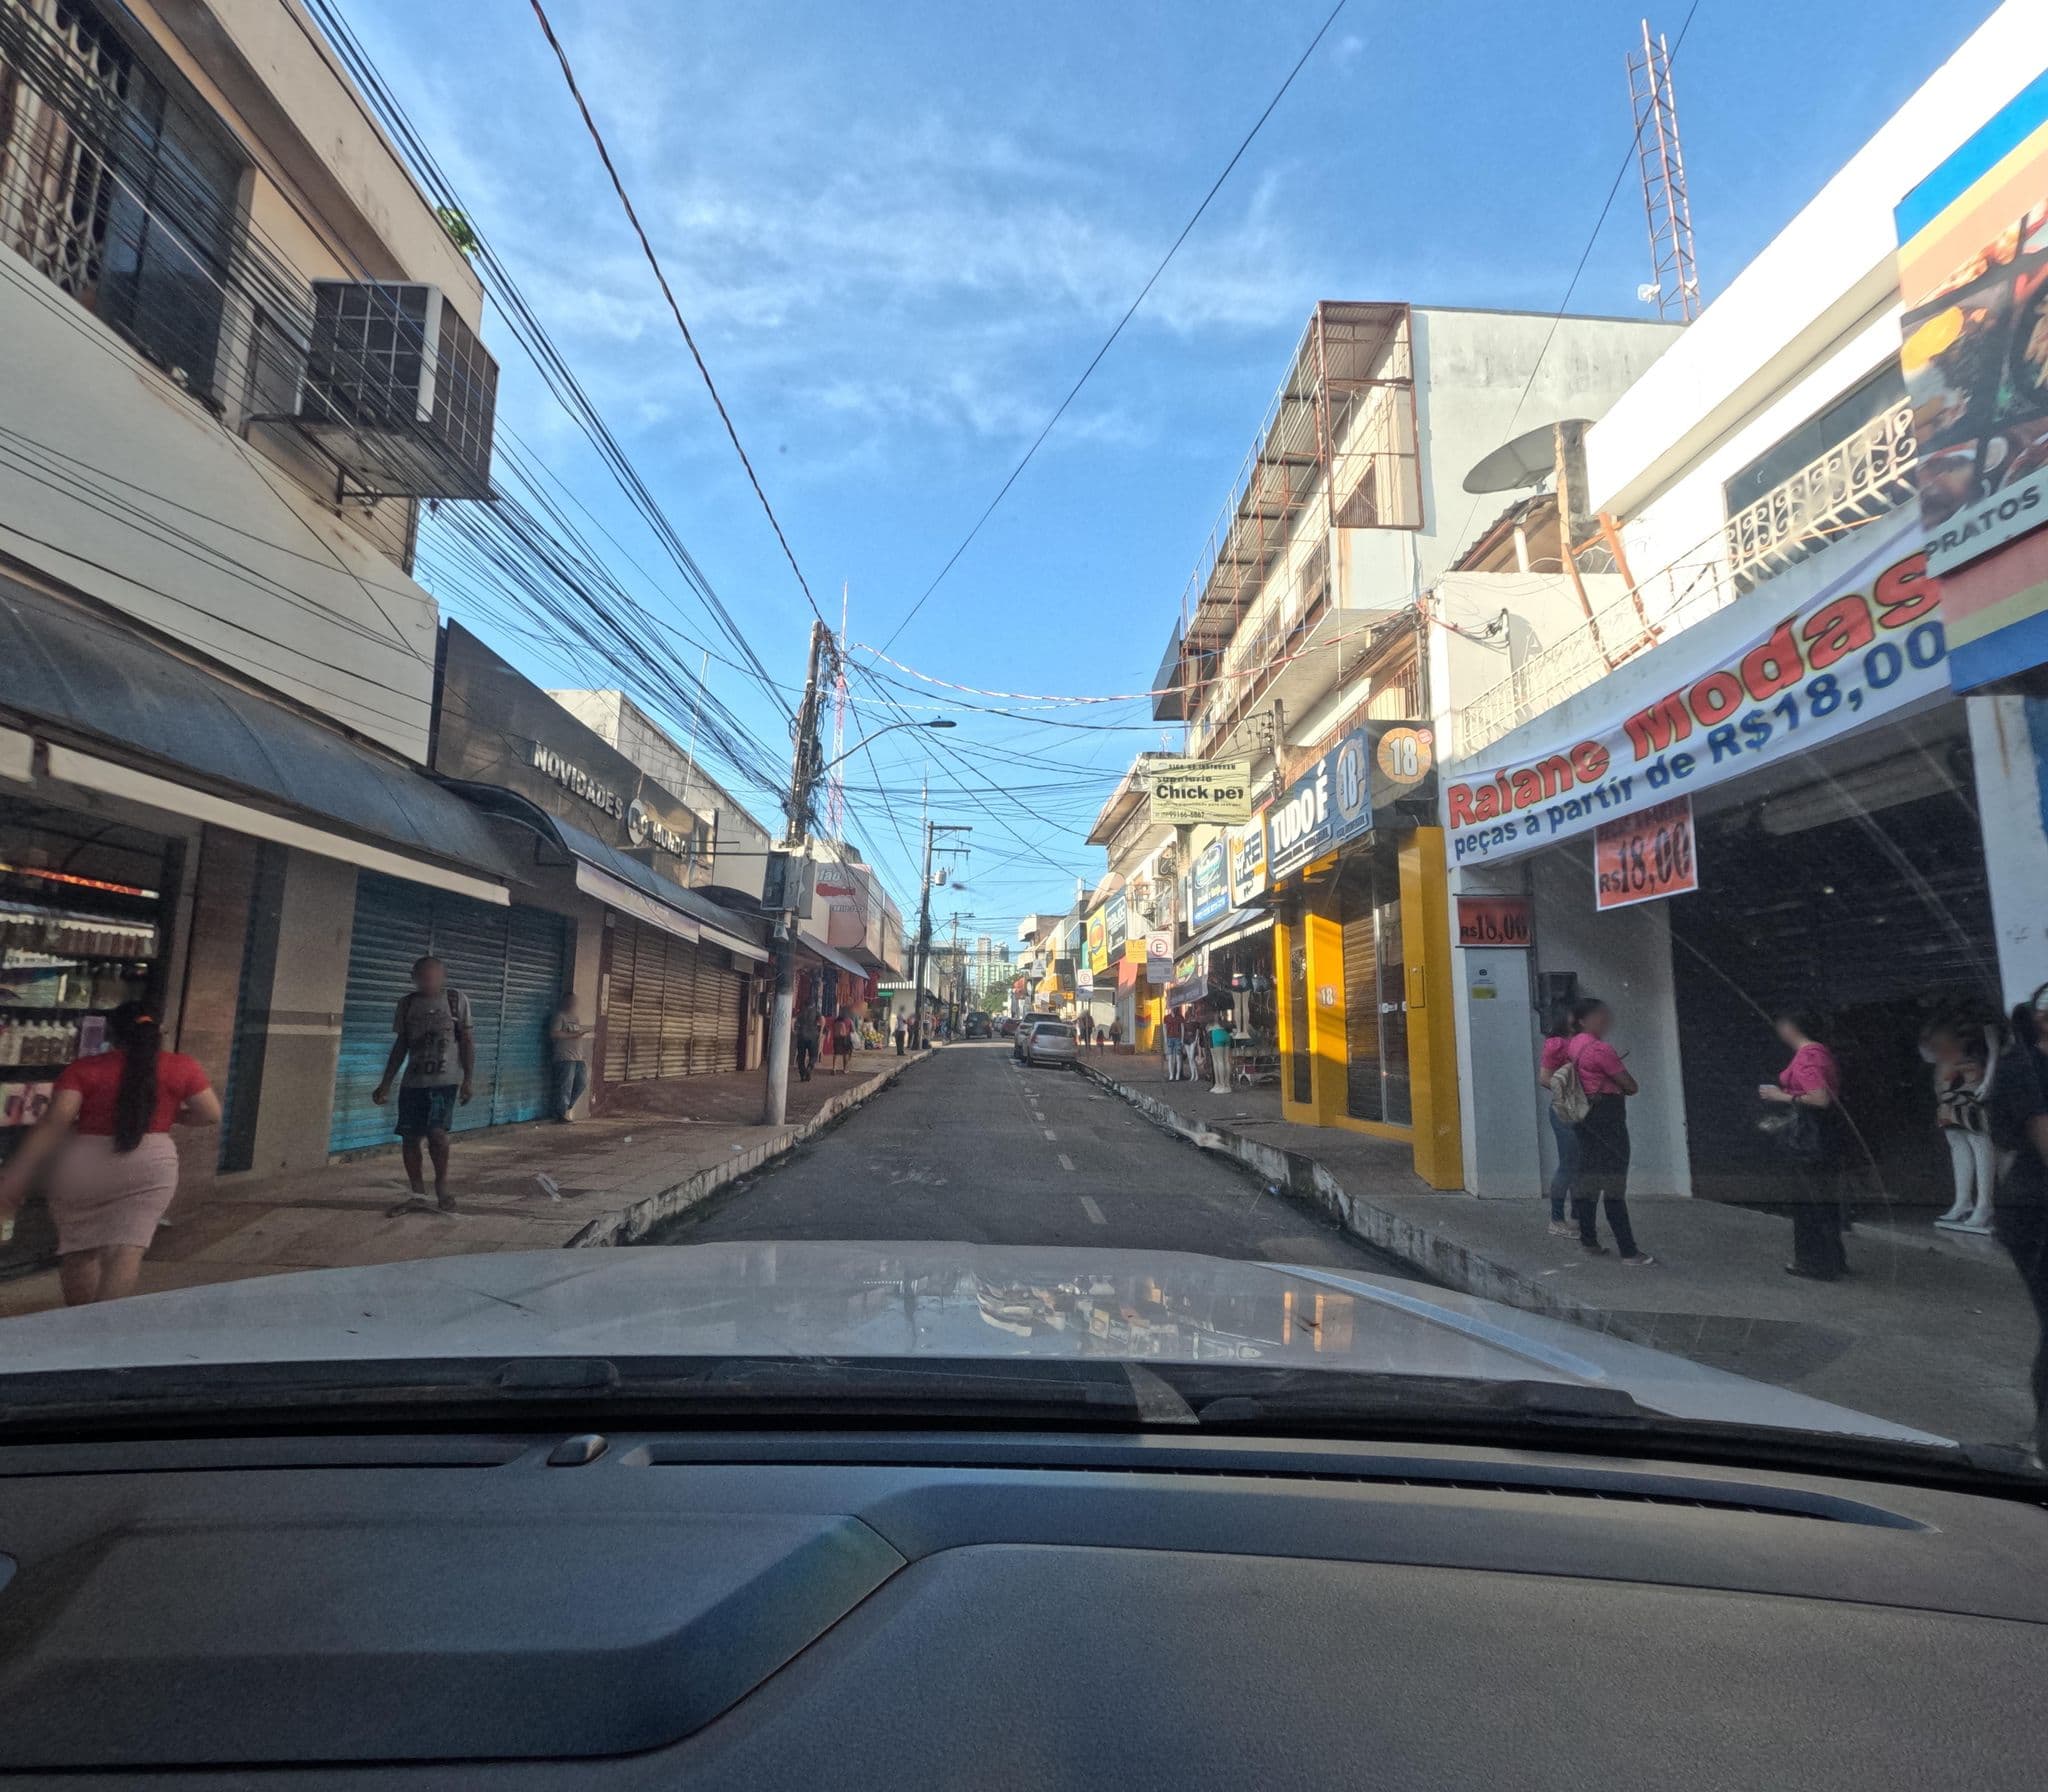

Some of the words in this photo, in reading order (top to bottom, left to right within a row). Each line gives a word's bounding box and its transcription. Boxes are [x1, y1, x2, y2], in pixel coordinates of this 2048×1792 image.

[1923, 485, 2041, 557] PRATOS
[1447, 740, 1610, 829] Raiane
[1623, 550, 1945, 761] Modas
[1389, 736, 1419, 777] 18
[1454, 819, 1518, 860] peças
[1546, 774, 1634, 834] partir
[1645, 751, 1697, 790] de
[1706, 619, 1947, 764] R$18,00
[534, 741, 624, 820] NOVIDADES
[1156, 784, 1209, 800] Chick
[1270, 788, 1315, 854] TUDO
[1155, 943, 1163, 953] E
[1320, 986, 1334, 1006] 18
